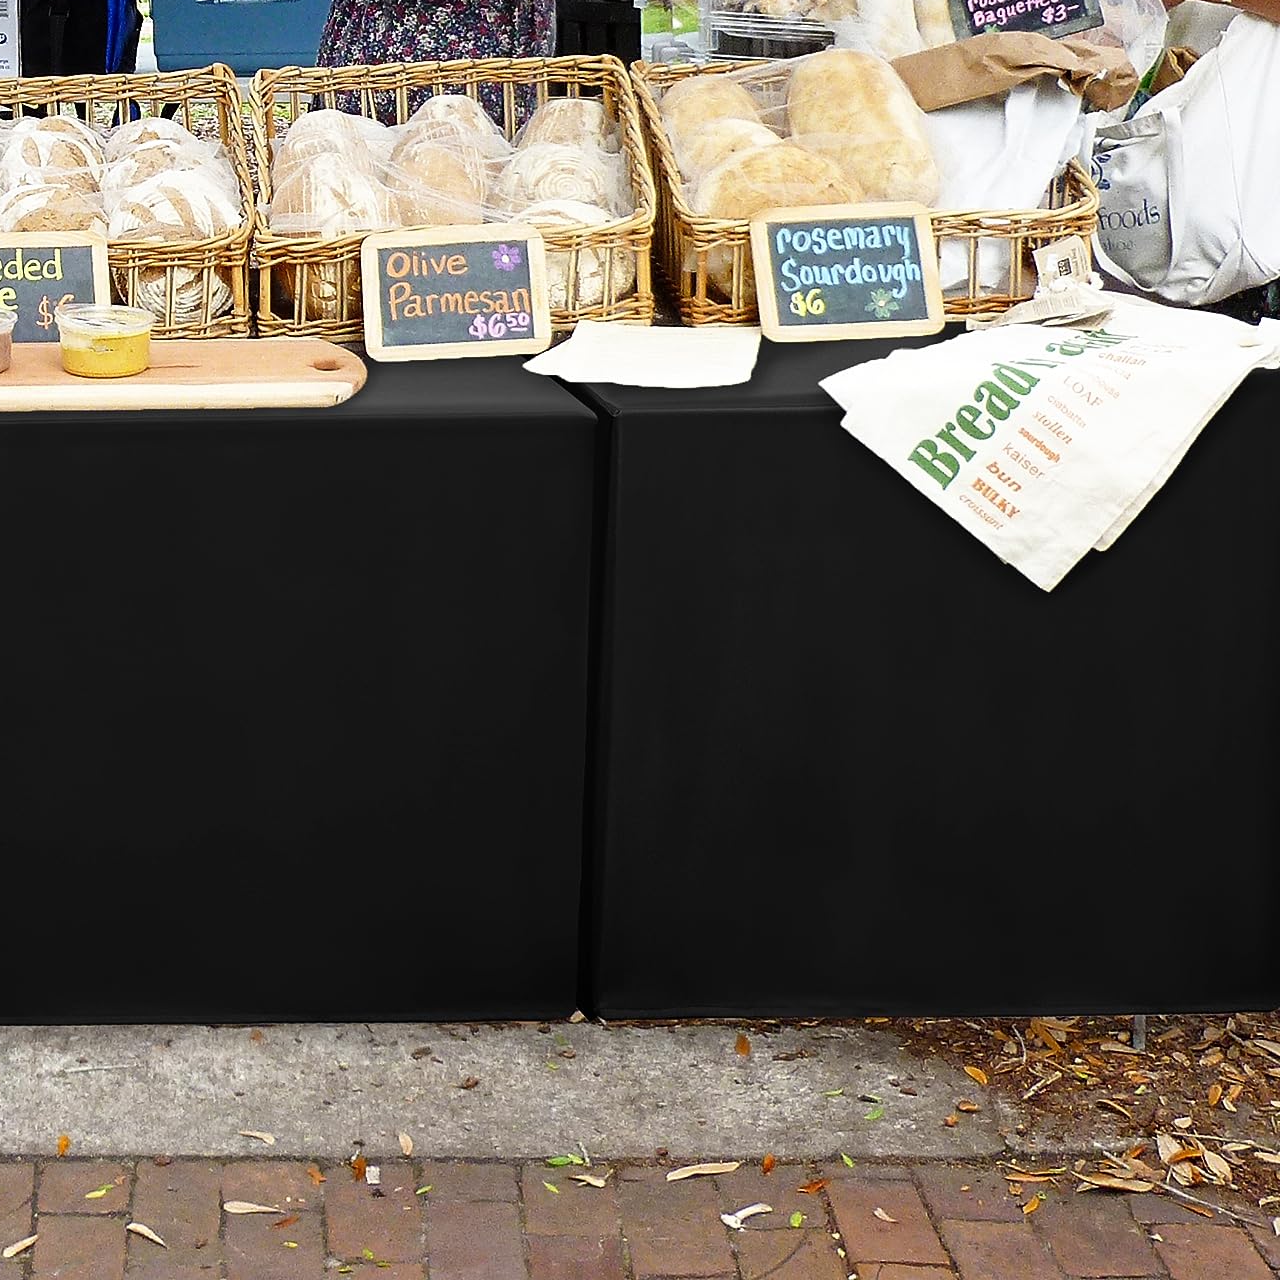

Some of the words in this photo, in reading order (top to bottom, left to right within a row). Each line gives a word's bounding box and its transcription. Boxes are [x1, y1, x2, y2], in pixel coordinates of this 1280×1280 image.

[1096, 199, 1161, 231] foods
[776, 225, 911, 261] rosemary
[386, 251, 469, 278] Olive
[388, 281, 532, 320] Parmesan
[789, 287, 827, 317] $6
[907, 362, 1041, 491] Bread
[1032, 410, 1073, 446] stollen
[1002, 441, 1046, 480] kaiser
[1018, 426, 1061, 464] sourdough
[985, 461, 1023, 493] bun
[959, 494, 1004, 531] croissant
[970, 476, 1021, 519] BULKY
